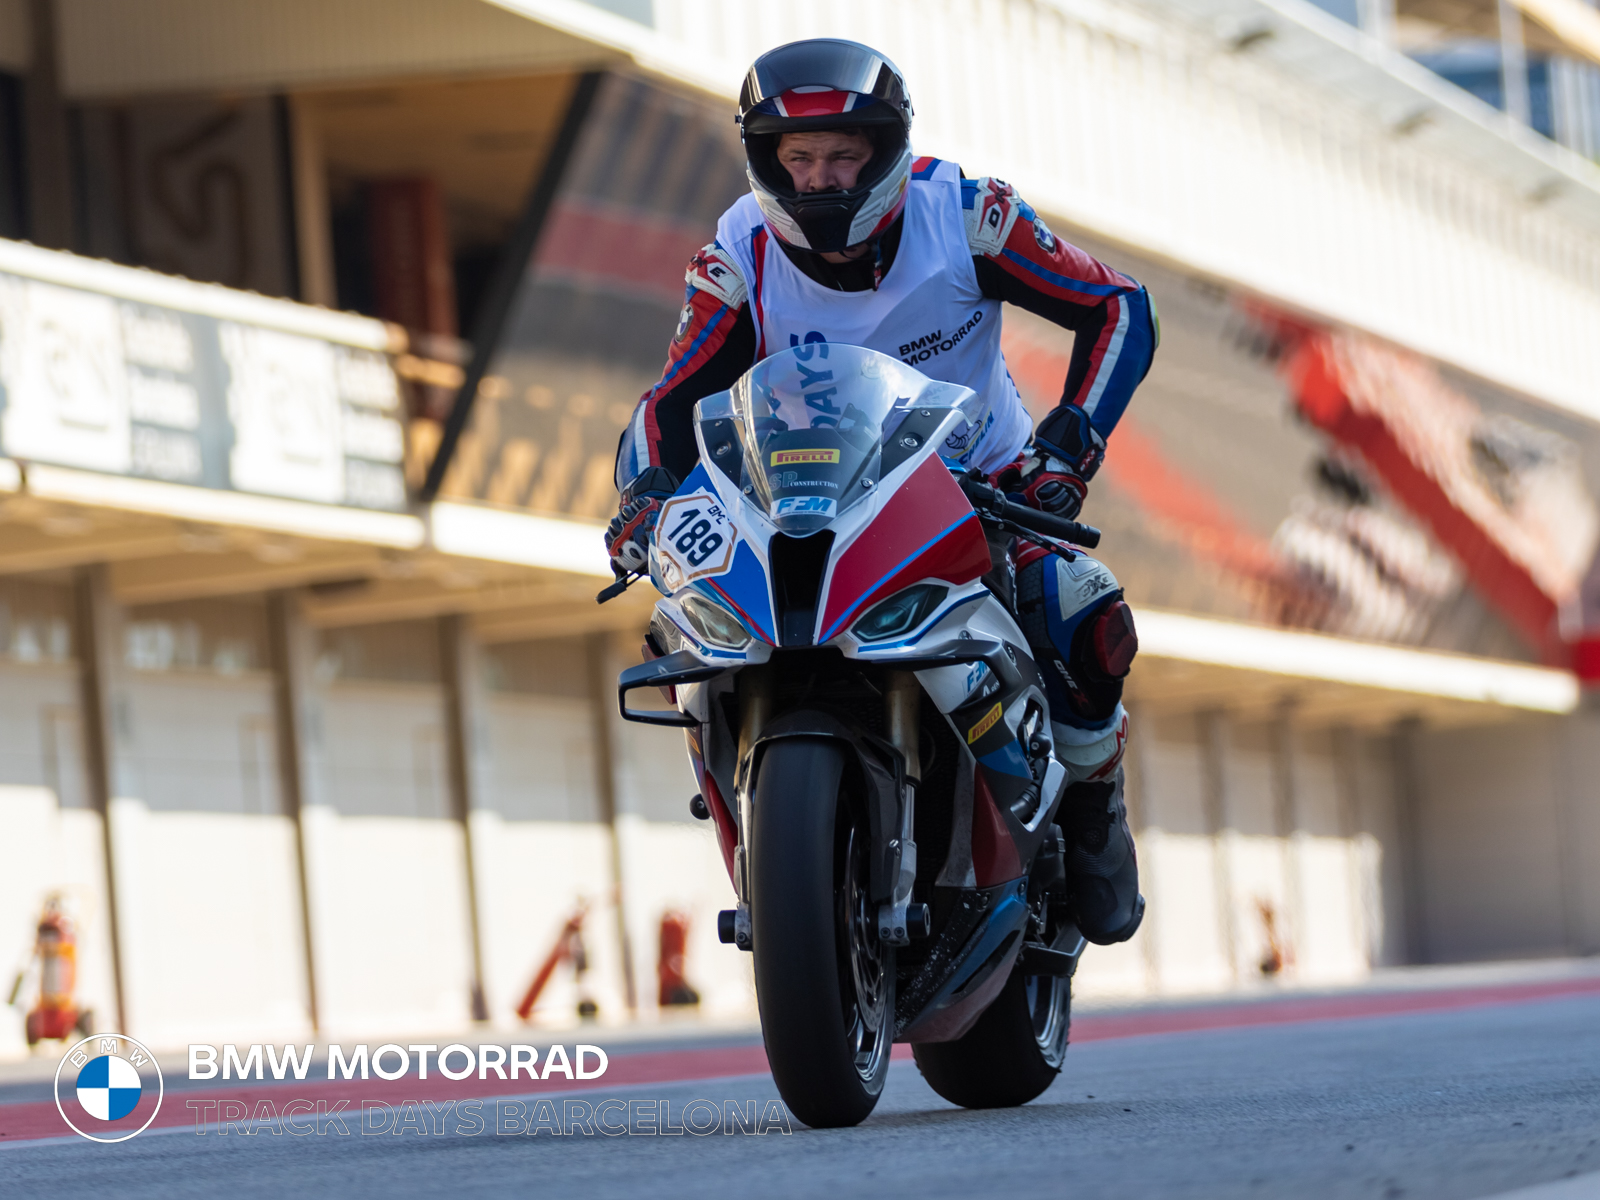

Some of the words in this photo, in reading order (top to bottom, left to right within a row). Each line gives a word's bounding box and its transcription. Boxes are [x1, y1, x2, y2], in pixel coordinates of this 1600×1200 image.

[898, 330, 942, 356] BMW
[902, 311, 983, 366] MOTORRAD
[776, 451, 834, 464] PIRELLI
[959, 410, 995, 465] CHELIN
[769, 471, 797, 490] SP
[790, 479, 839, 490] CONSTRUCTION
[667, 508, 723, 567] 189
